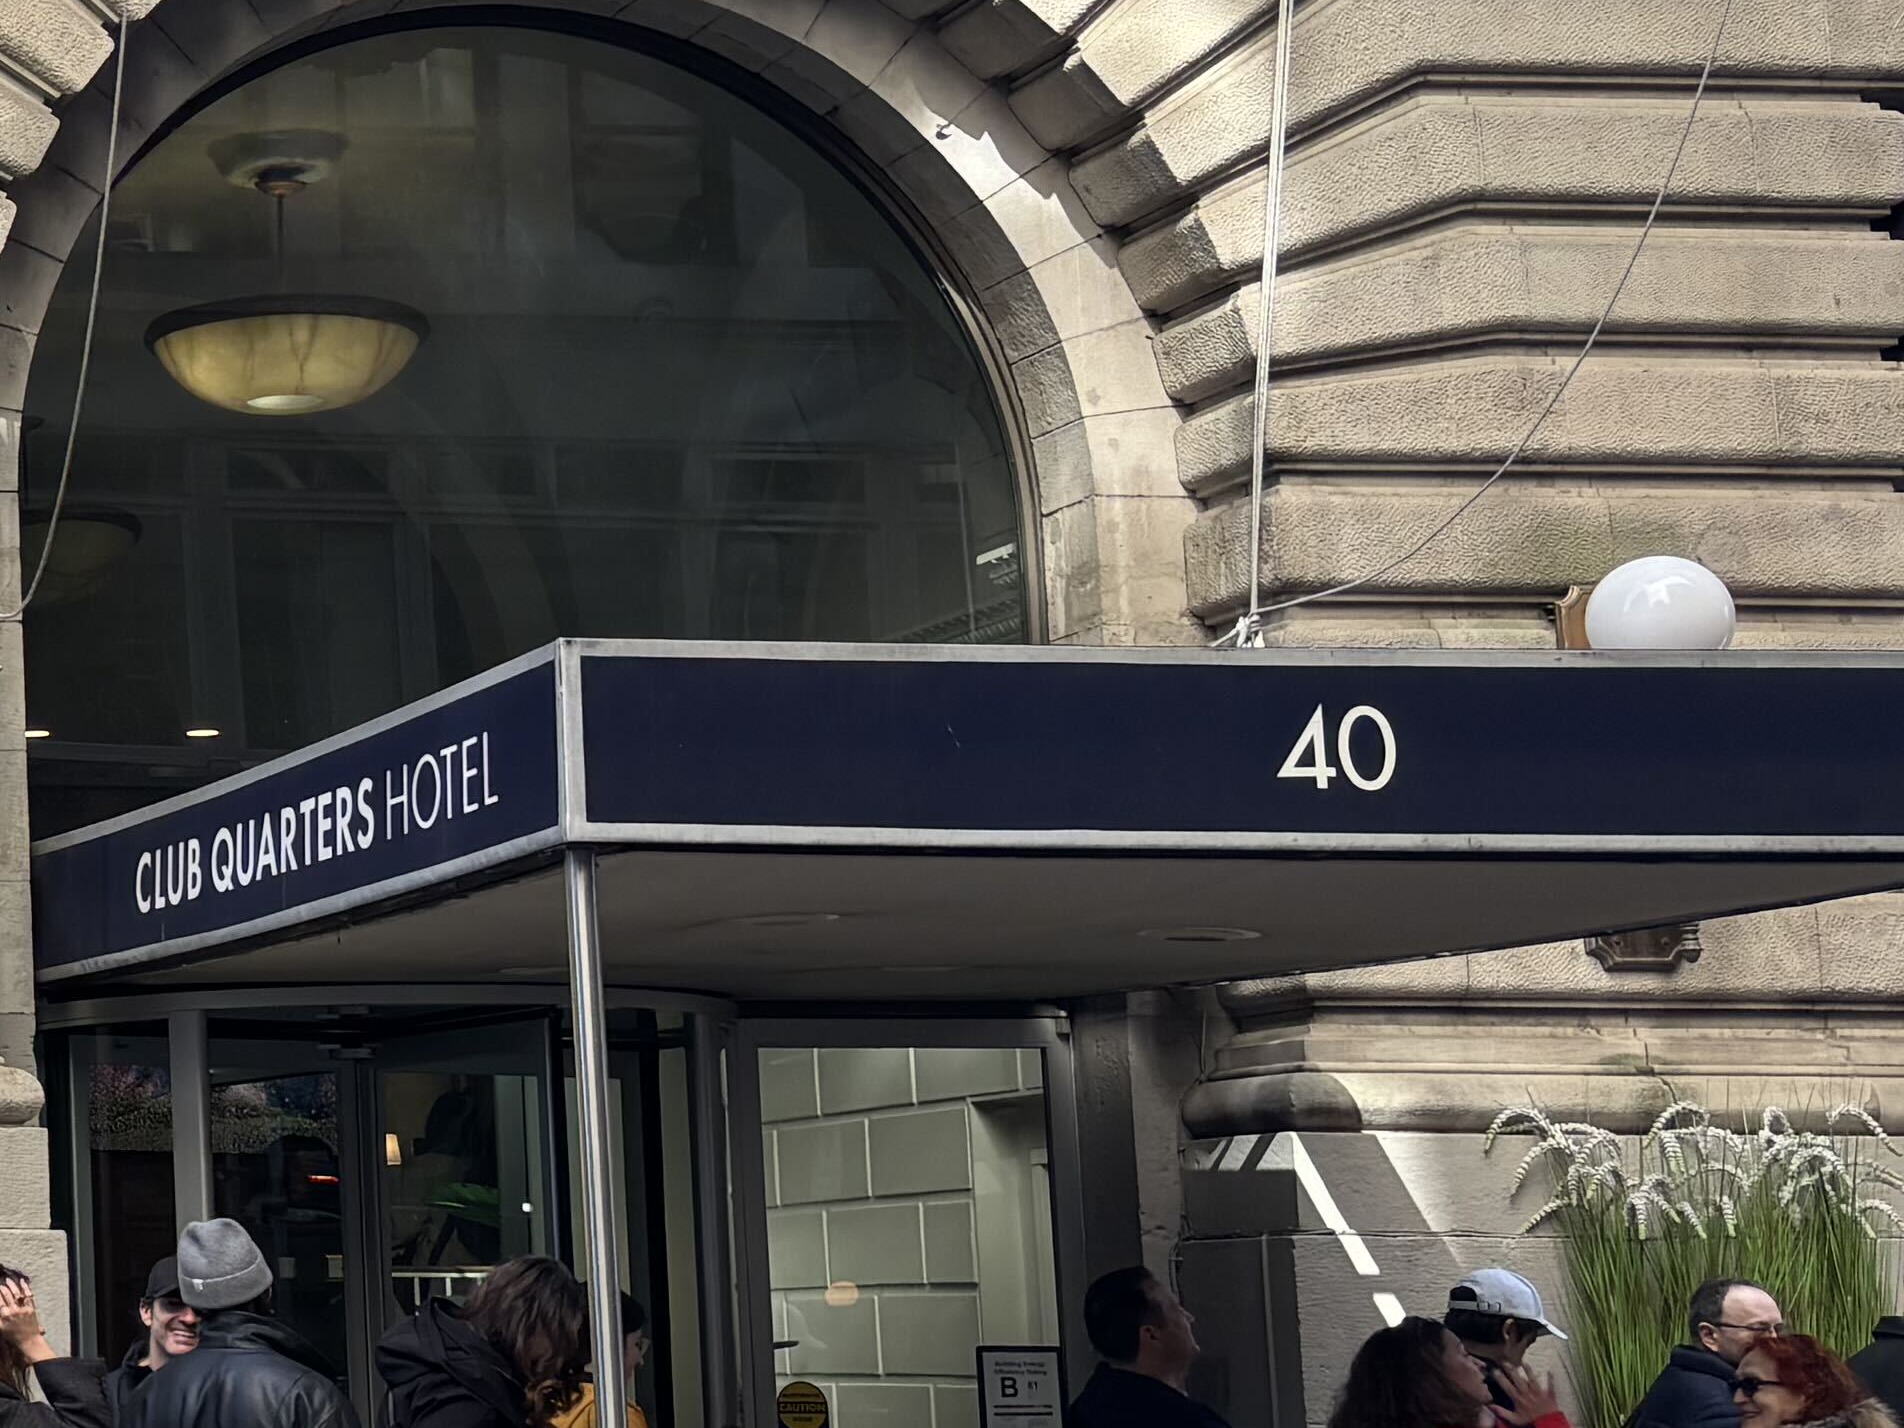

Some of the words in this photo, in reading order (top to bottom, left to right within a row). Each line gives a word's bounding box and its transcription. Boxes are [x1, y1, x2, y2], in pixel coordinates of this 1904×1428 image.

[1276, 703, 1397, 791] 40
[135, 839, 202, 914] CLUB
[211, 777, 375, 893] QUARTERS
[386, 731, 499, 840] HOTEL
